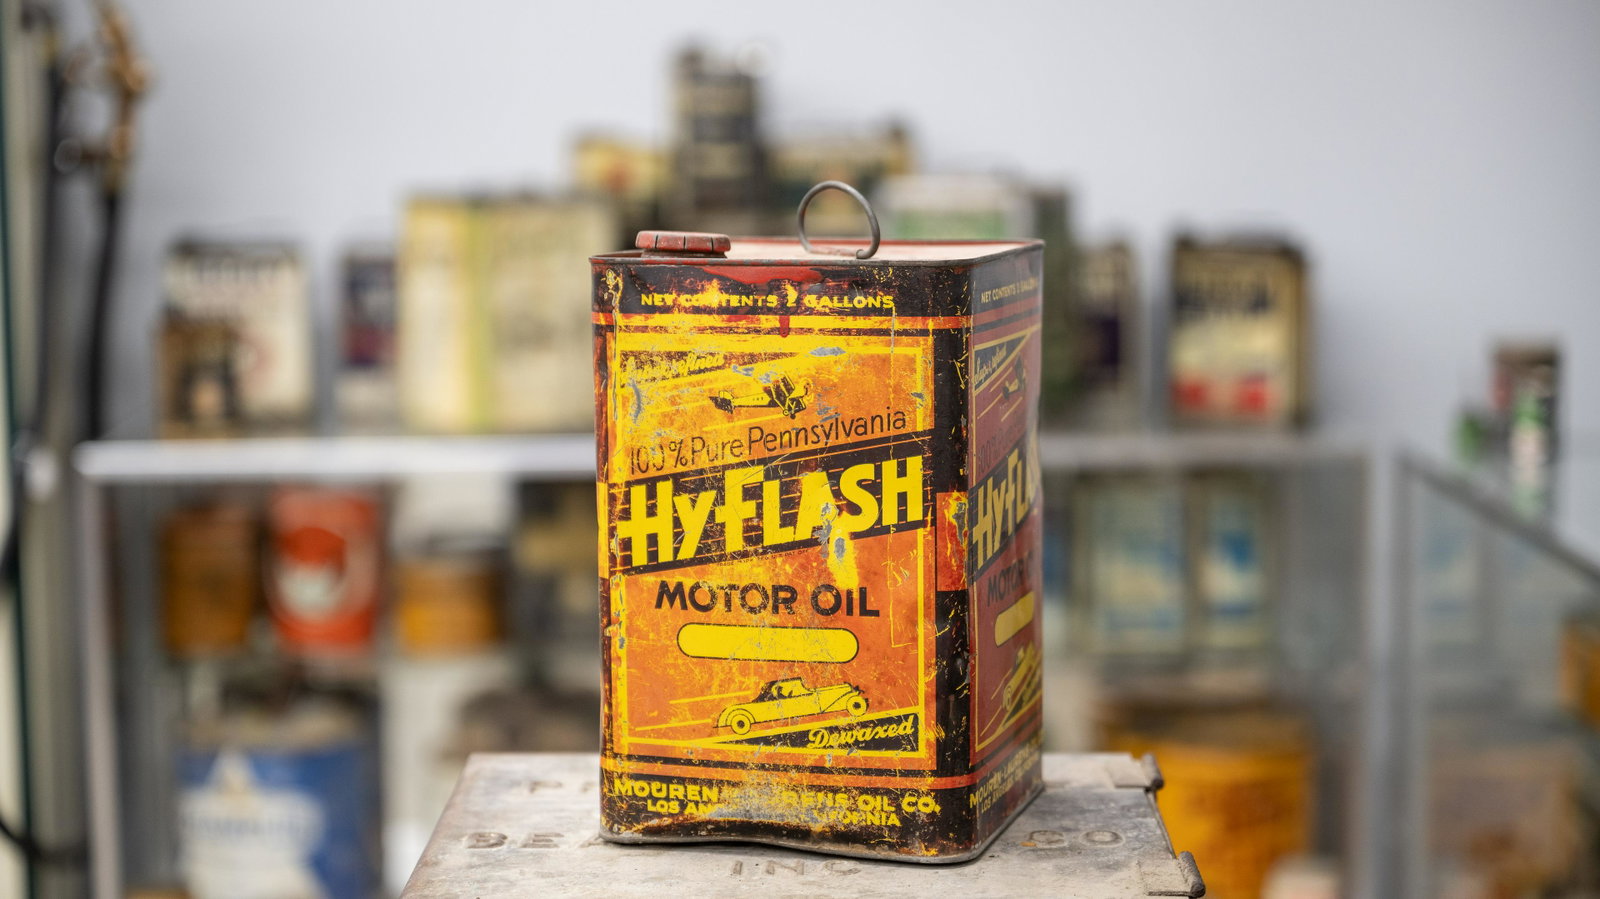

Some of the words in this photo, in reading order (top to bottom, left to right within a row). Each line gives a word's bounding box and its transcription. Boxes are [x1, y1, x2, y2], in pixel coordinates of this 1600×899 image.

[683, 294, 778, 308] COTENTS
[804, 294, 895, 309] GALLONS
[690, 436, 743, 466] Pure
[749, 406, 907, 456] Pennsylvania
[654, 580, 798, 616] MOTOR
[810, 584, 881, 618] OIL
[807, 714, 916, 749] Dewaxed
[647, 799, 680, 814] LOS
[857, 794, 897, 812] OIL
